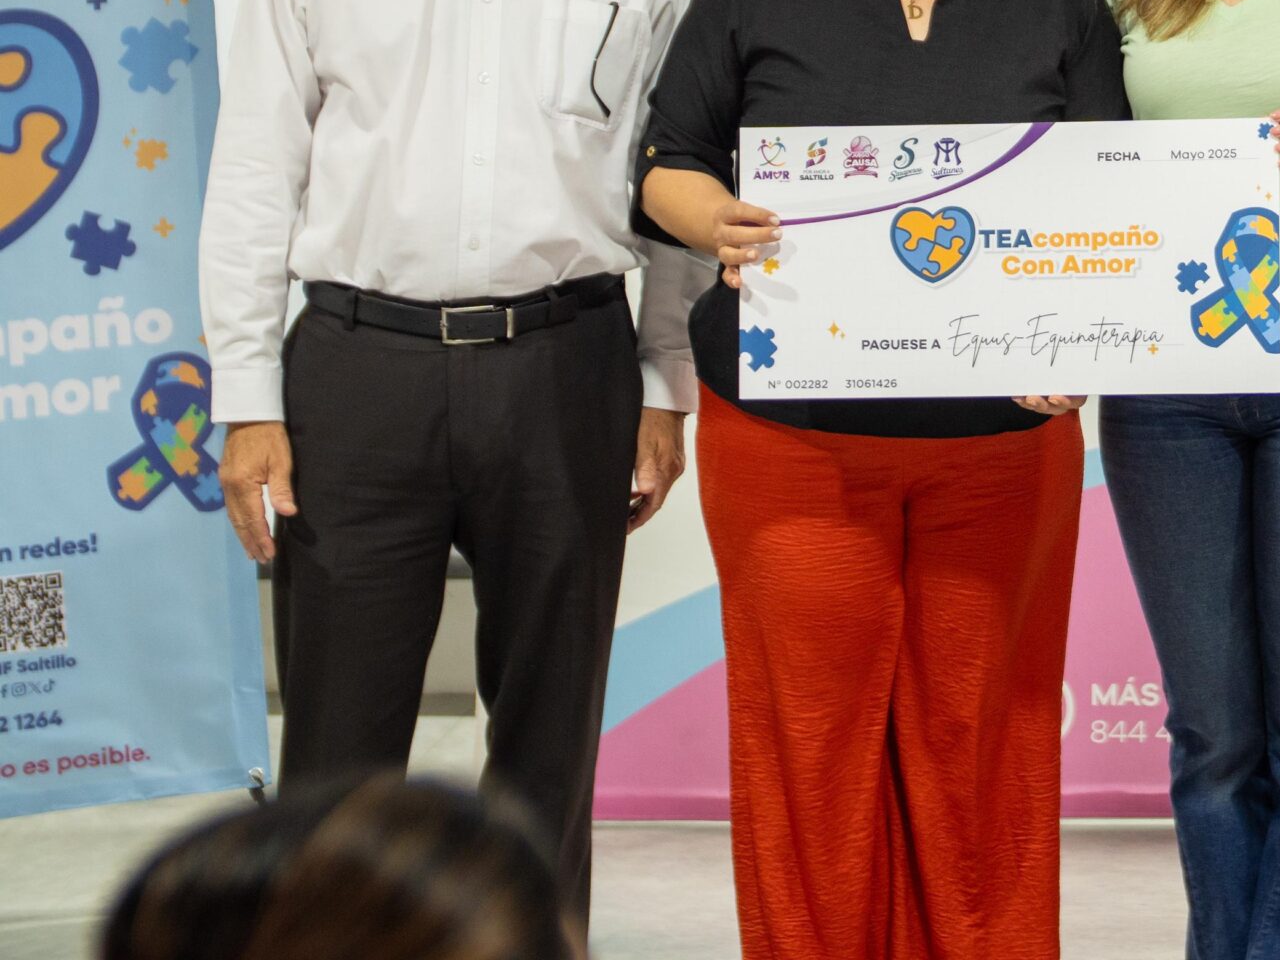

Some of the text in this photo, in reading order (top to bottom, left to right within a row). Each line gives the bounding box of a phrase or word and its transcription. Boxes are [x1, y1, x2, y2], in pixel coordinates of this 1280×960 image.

[1097, 148, 1237, 162] FECHA Mayo 2025
[978, 225, 1159, 251] TEAcompaño
[1002, 254, 1136, 275] Con Amor
[0, 295, 174, 366] paño
[861, 339, 928, 351] PAGUESE
[931, 339, 941, 350] A
[785, 379, 828, 389] 002282
[845, 378, 898, 389] 31061426
[19, 532, 98, 560] redes!
[17, 654, 77, 673] Saltillo
[1090, 676, 1160, 707] MÁS
[13, 709, 63, 730] 1264
[1090, 720, 1148, 743] 844
[23, 759, 50, 775] es
[57, 743, 151, 775] posible.
